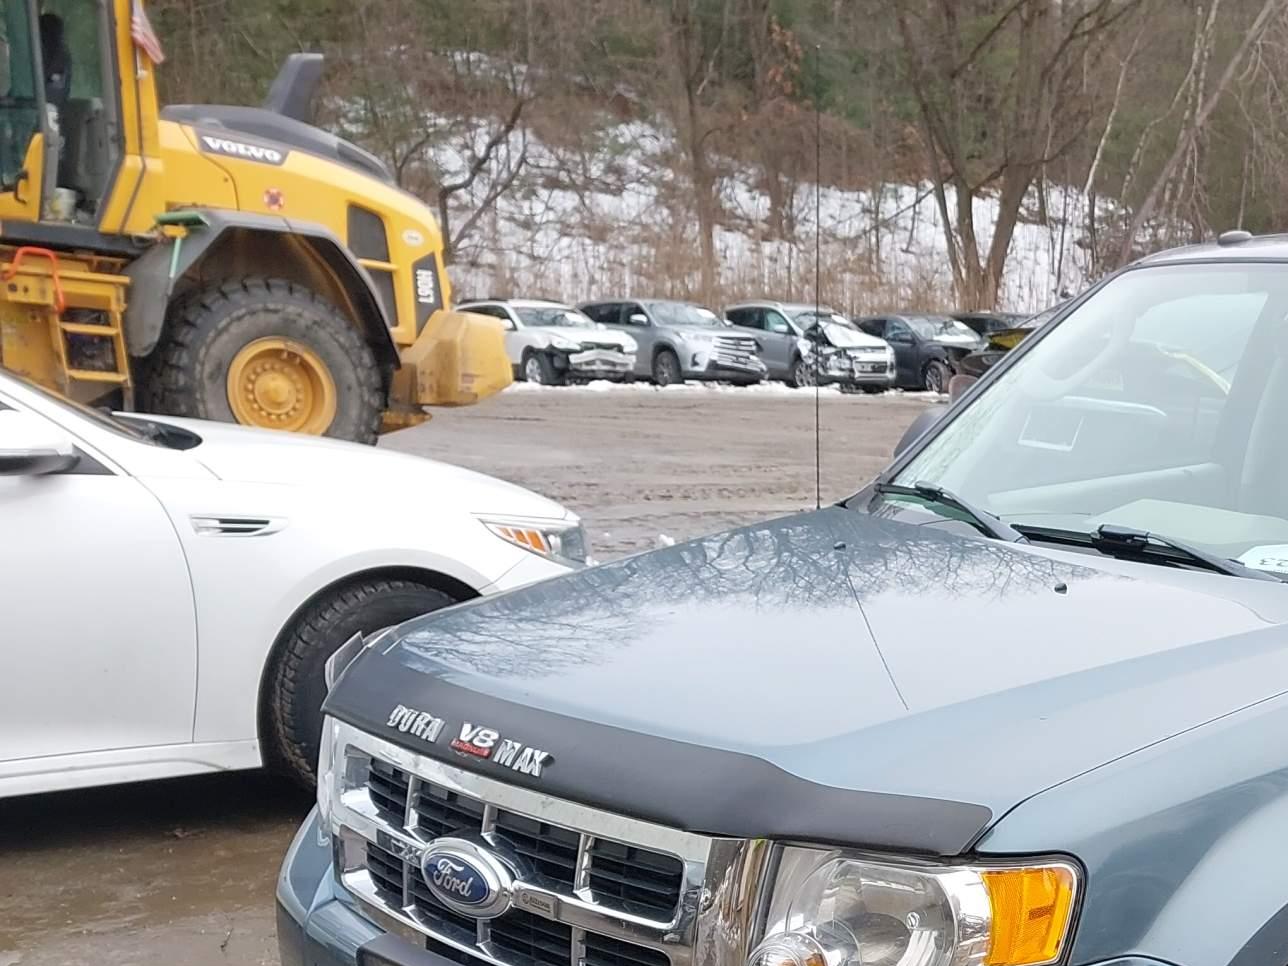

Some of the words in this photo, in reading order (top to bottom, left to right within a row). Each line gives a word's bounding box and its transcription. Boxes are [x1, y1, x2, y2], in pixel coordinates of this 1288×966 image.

[201, 135, 282, 163] VOLVO
[415, 269, 434, 304] L90H
[387, 704, 445, 743] DURA
[459, 722, 499, 748] V8
[494, 739, 550, 777] MAX
[433, 858, 474, 897] Ford
